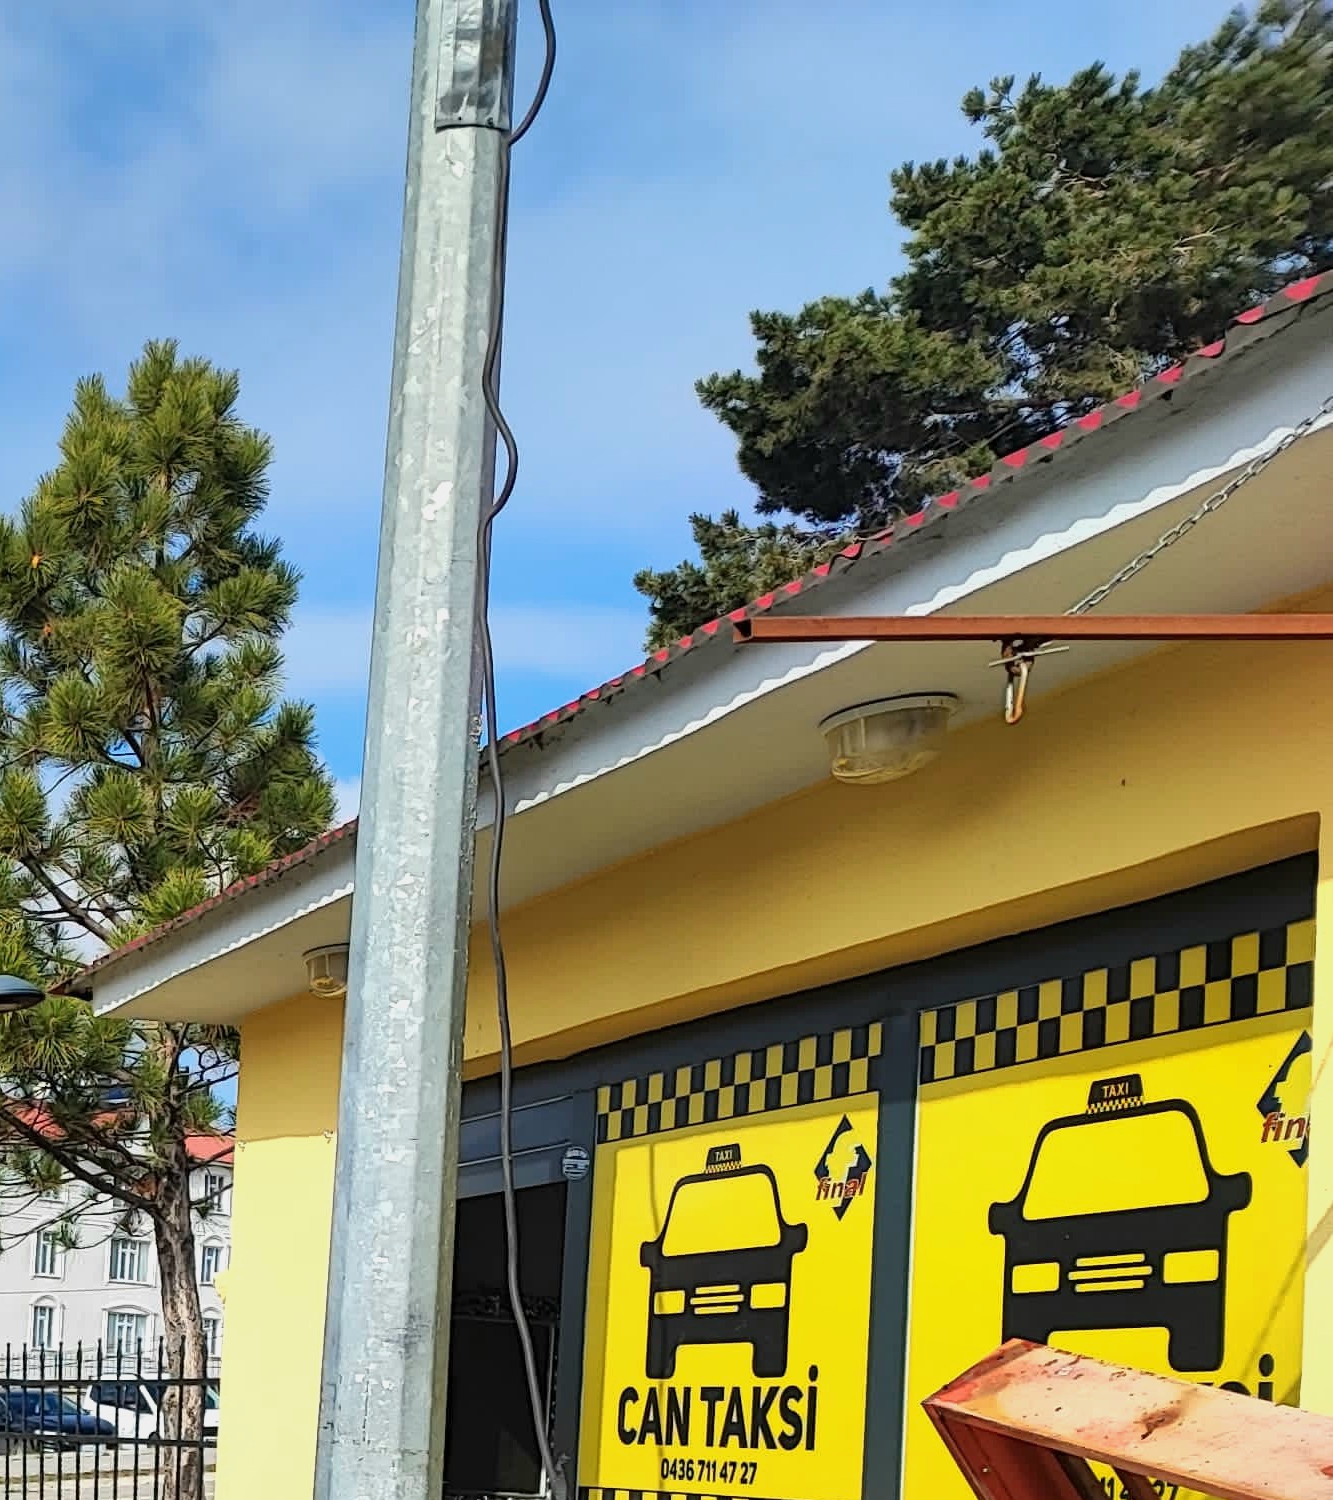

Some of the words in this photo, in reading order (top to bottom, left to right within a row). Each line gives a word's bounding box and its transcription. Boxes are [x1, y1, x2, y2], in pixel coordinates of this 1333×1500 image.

[1102, 1082, 1129, 1098] TAXI
[714, 1150, 733, 1162] TAXI
[816, 1172, 867, 1200] final
[617, 1386, 692, 1446] CAN
[700, 1365, 819, 1451] TAKSİ
[661, 1458, 694, 1481] 0436
[697, 1460, 717, 1483] 711
[719, 1461, 737, 1484] 47
[740, 1462, 758, 1485] 27
